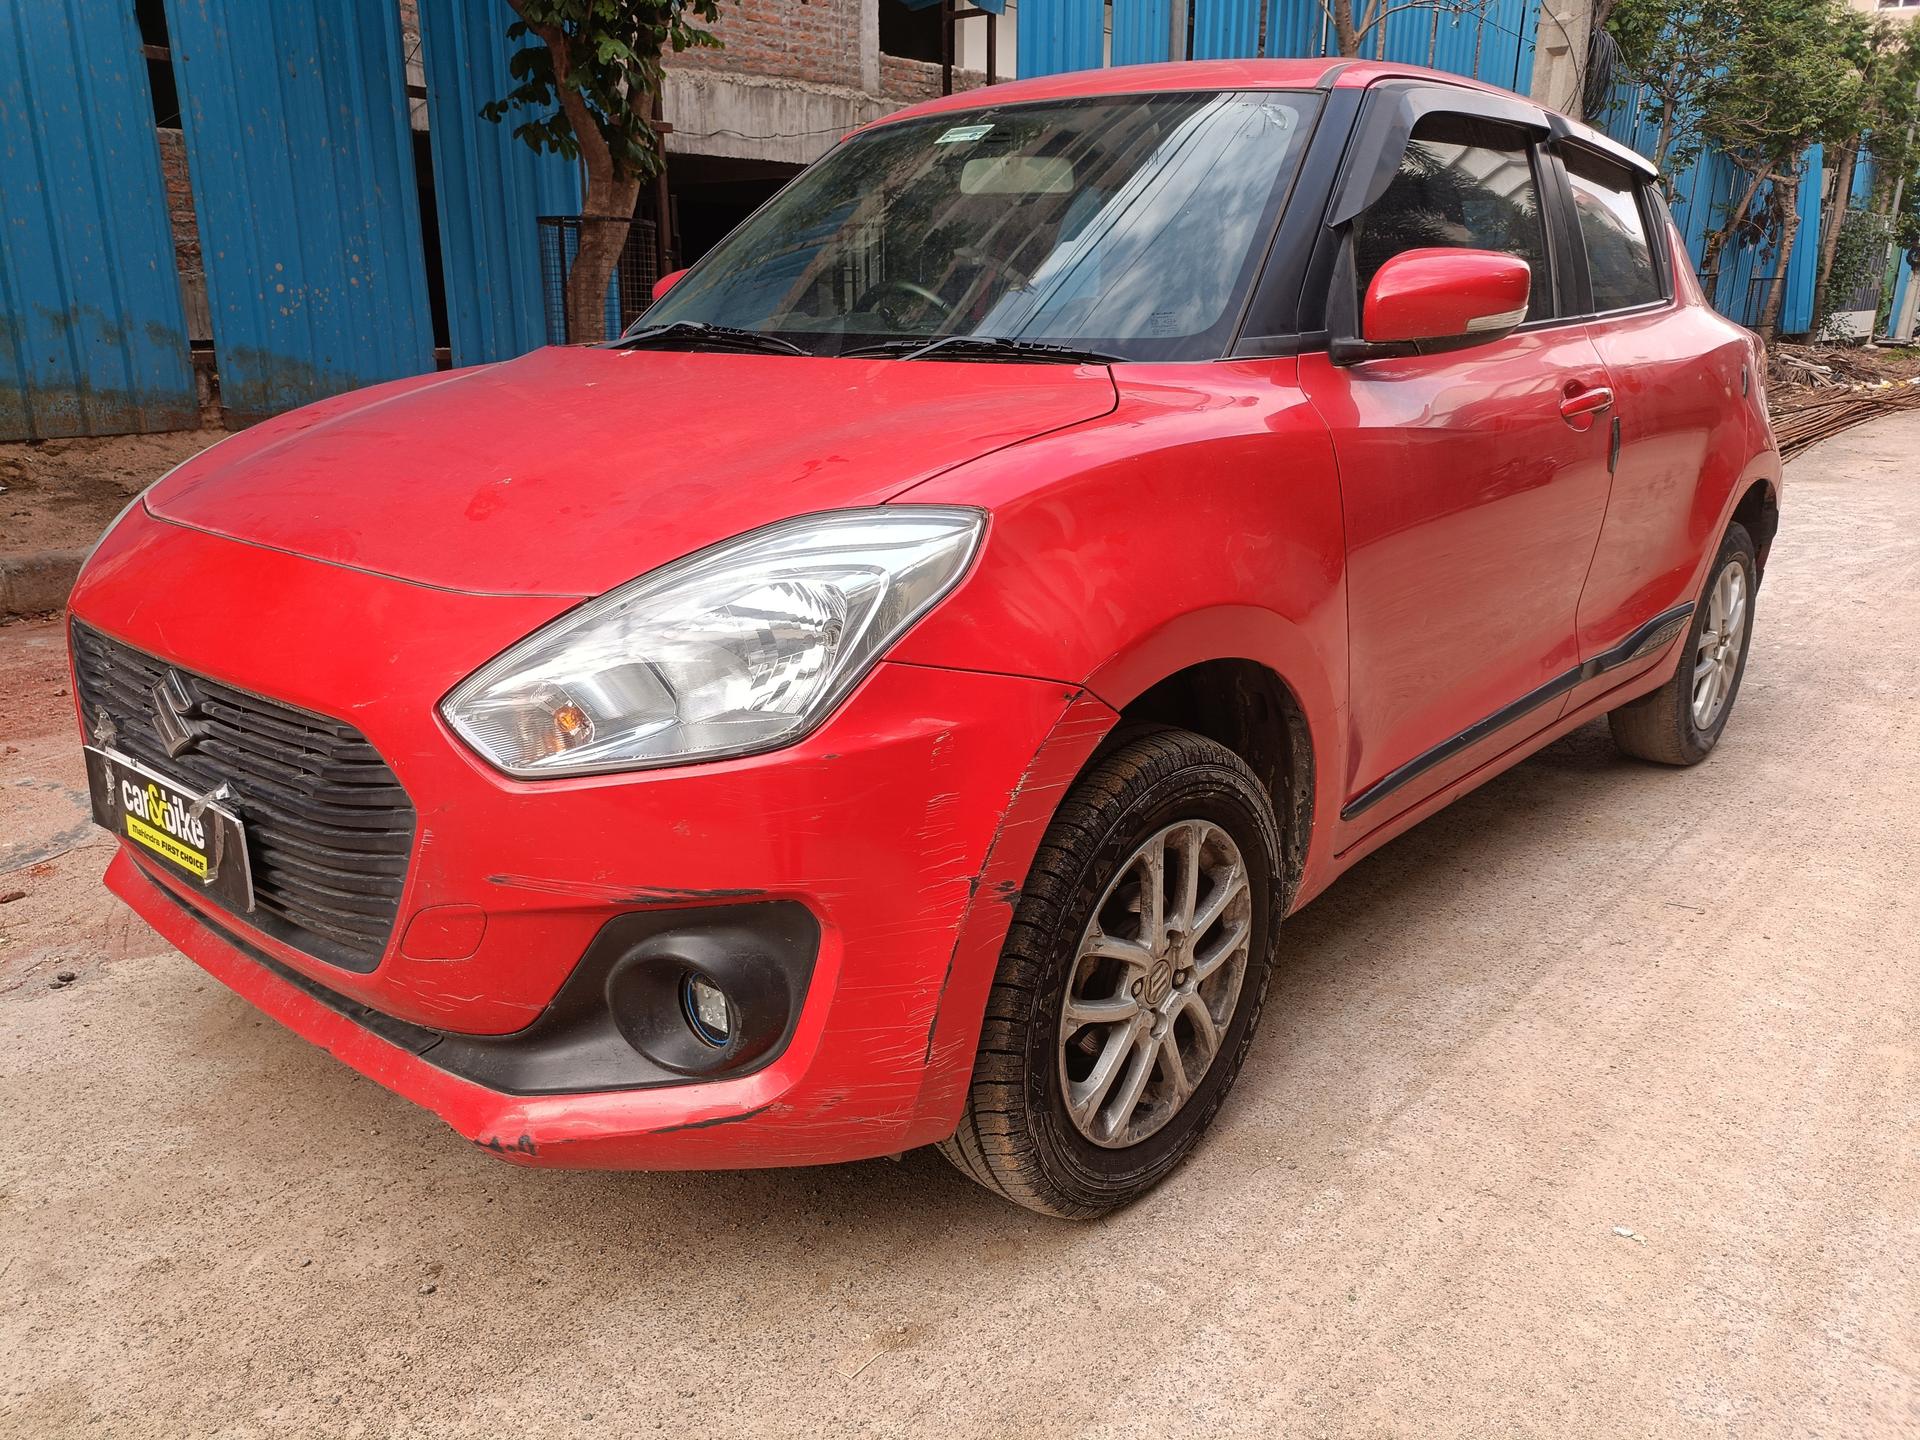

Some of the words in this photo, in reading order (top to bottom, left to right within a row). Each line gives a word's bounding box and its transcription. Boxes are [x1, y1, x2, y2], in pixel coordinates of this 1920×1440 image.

[122, 780, 205, 849] car&bike
[161, 840, 180, 857] FIRST
[180, 851, 204, 870] CHOICE
